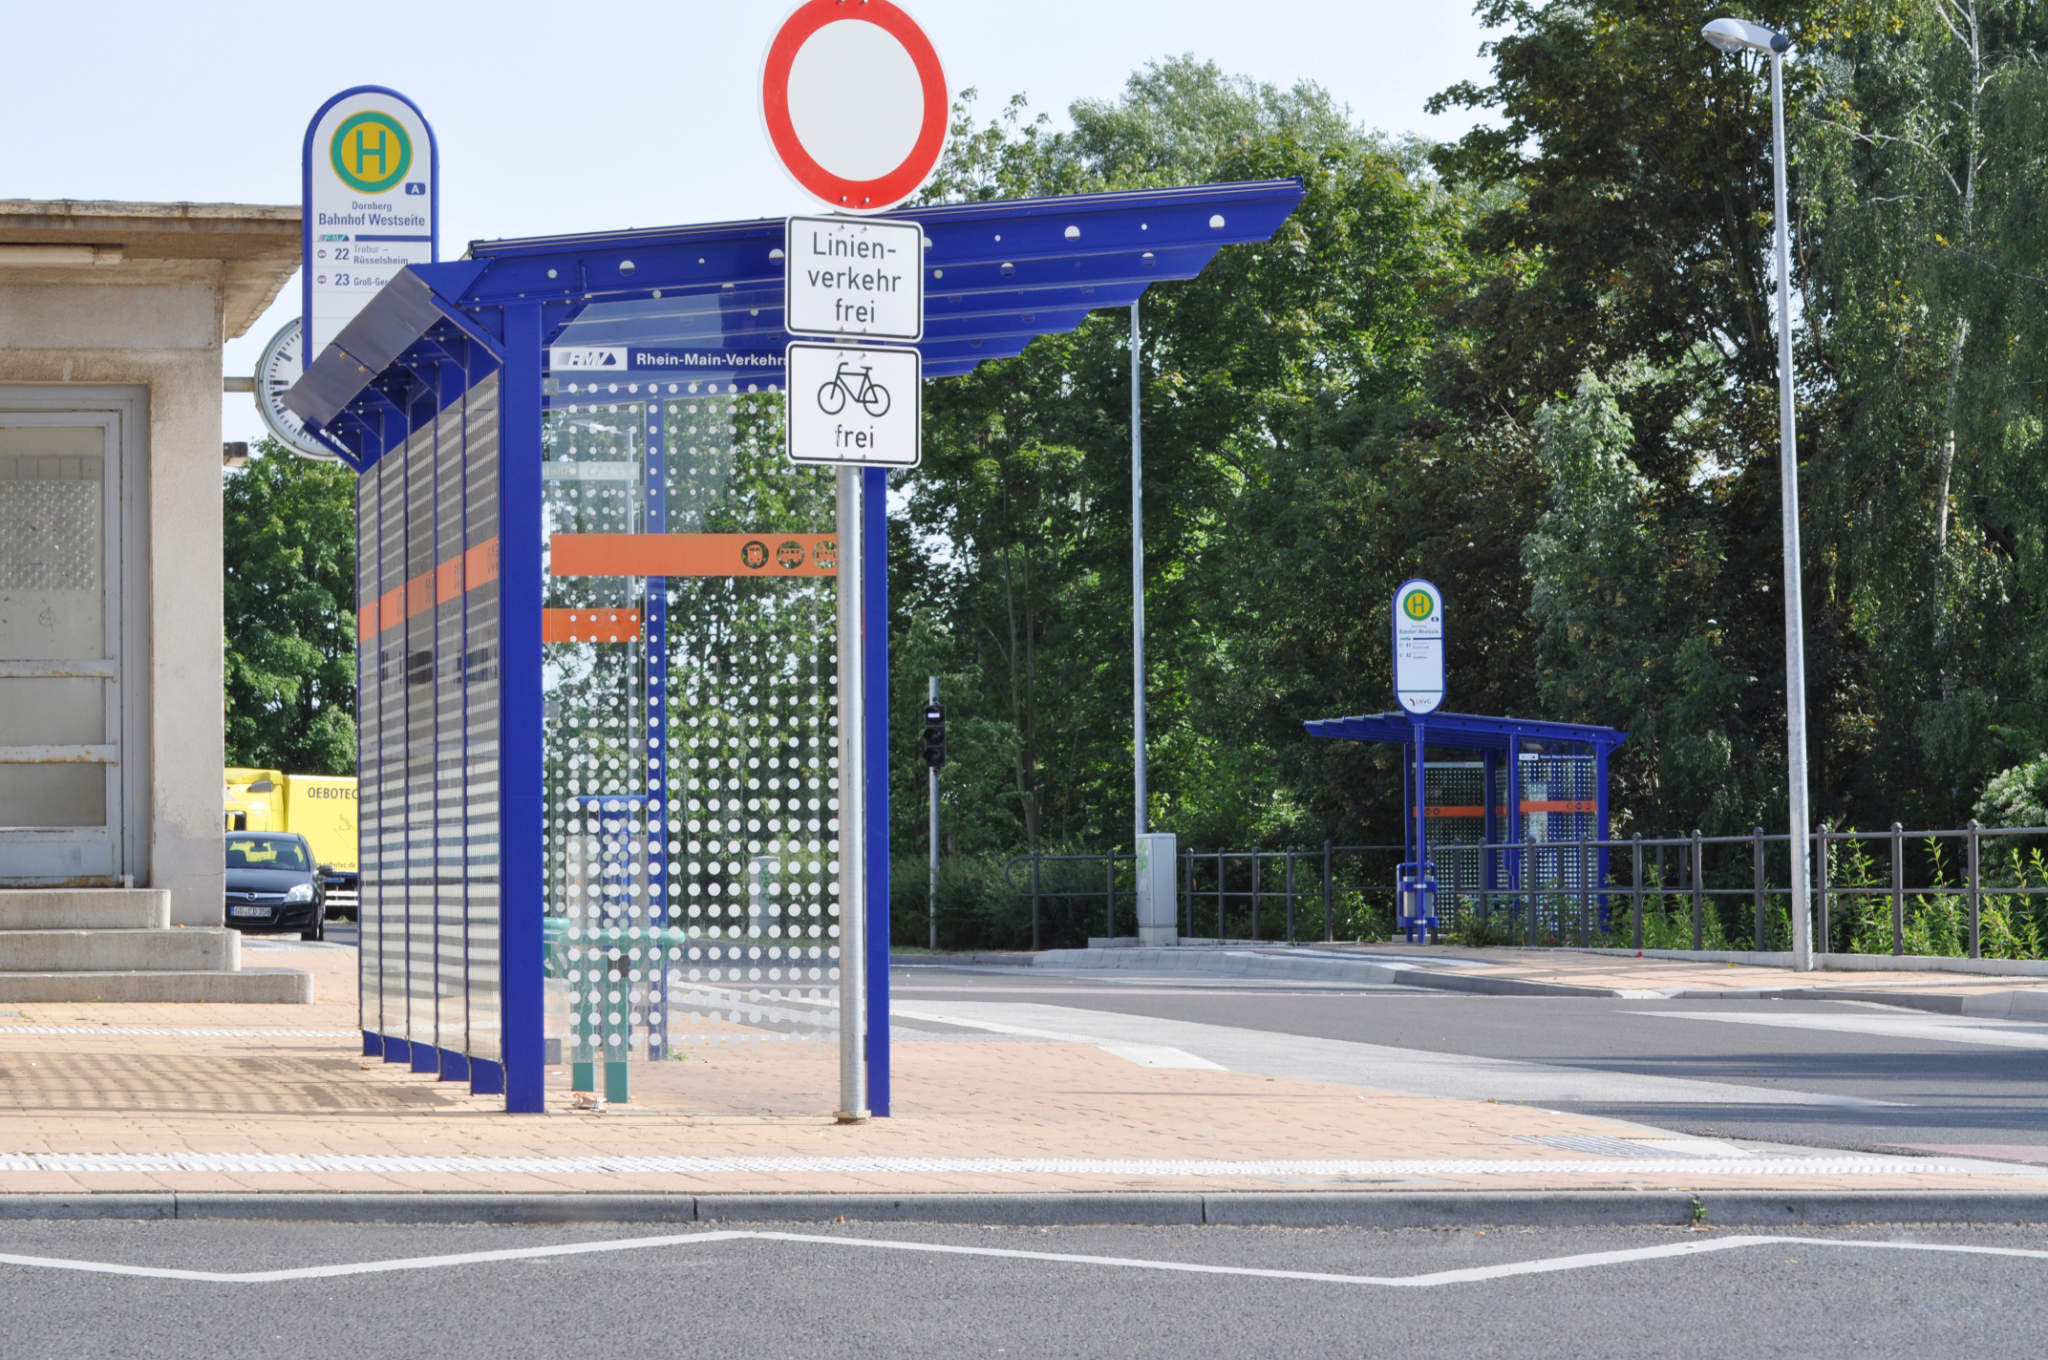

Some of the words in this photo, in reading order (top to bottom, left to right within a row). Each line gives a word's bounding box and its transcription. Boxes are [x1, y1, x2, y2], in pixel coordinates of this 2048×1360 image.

[356, 130, 387, 174] H
[411, 184, 420, 194] A
[352, 201, 392, 212] Dornberg
[319, 213, 365, 226] Bahnhof
[368, 213, 425, 226] Westseite
[813, 232, 897, 259] Linien-
[335, 248, 350, 260] 22
[353, 255, 409, 265] Rüsselsheim
[335, 273, 350, 286] 23
[808, 266, 902, 293] verkehr
[835, 298, 875, 323] frei
[835, 424, 874, 448] frei
[1412, 596, 1425, 613] H
